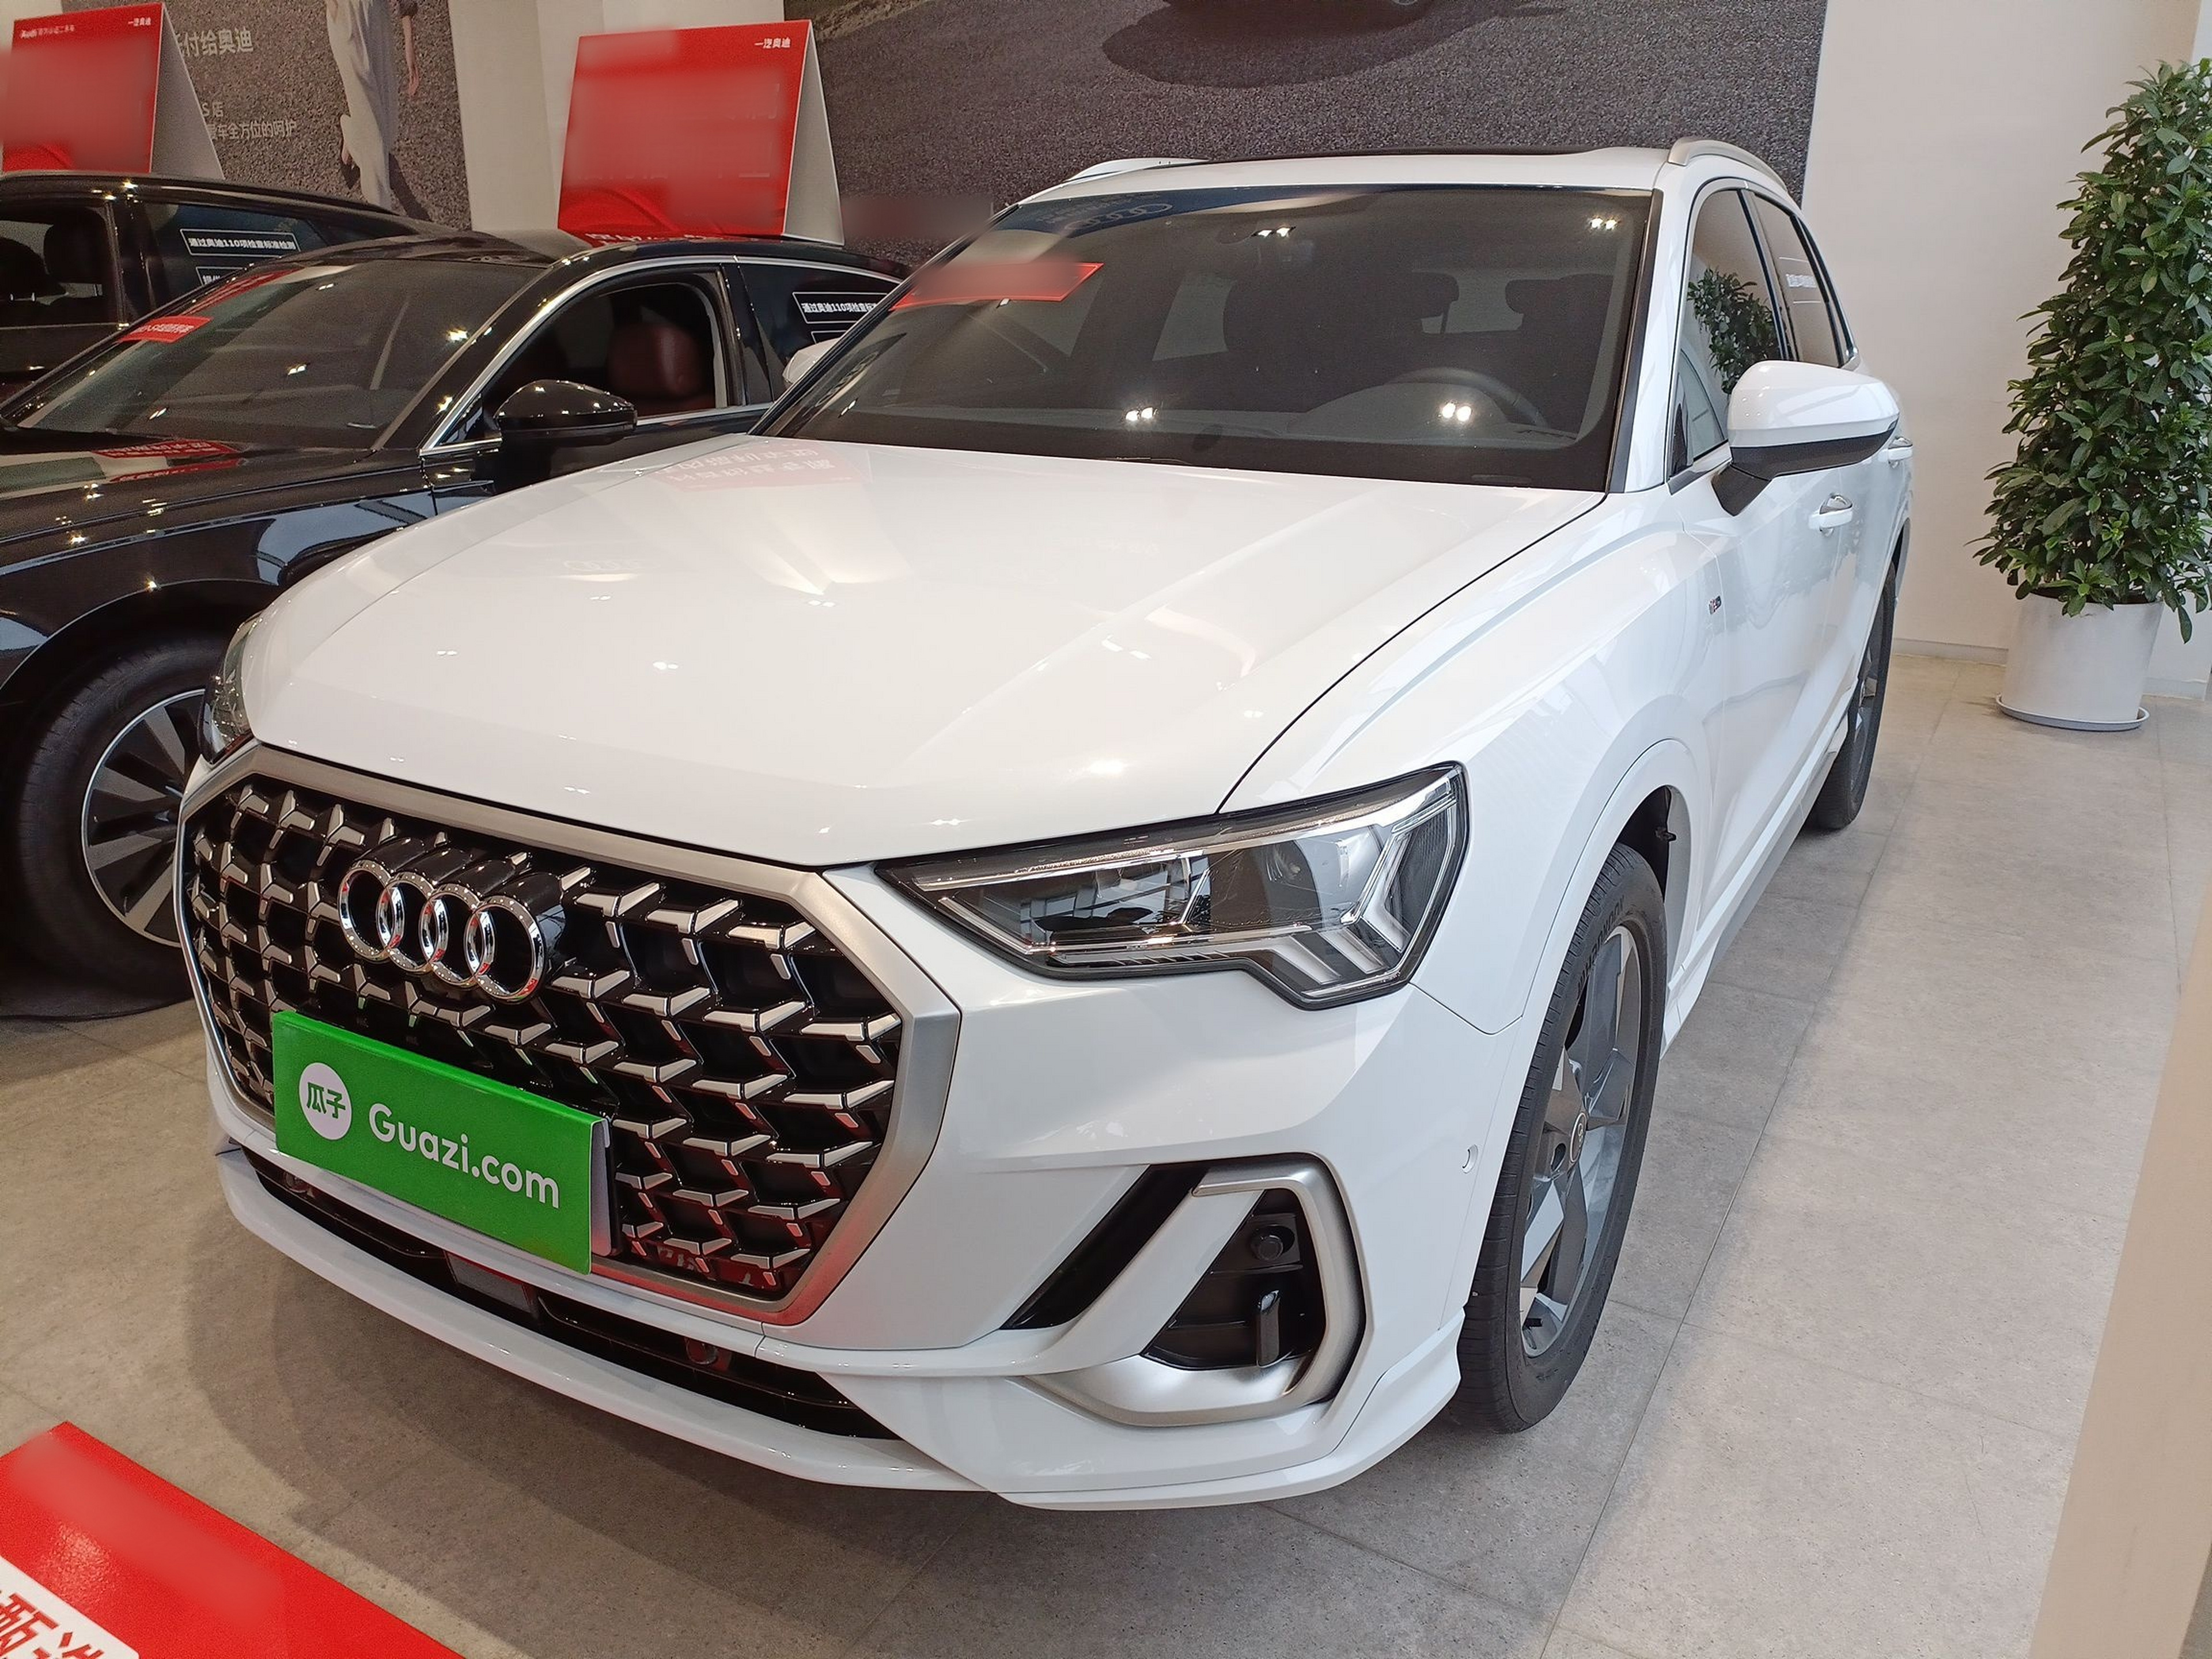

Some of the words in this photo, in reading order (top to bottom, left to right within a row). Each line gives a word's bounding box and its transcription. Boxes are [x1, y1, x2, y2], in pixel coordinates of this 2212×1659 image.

[175, 26, 254, 57] 付给奥迪
[306, 1082, 346, 1119] 瓜子
[369, 1103, 560, 1209] Guazi.com
